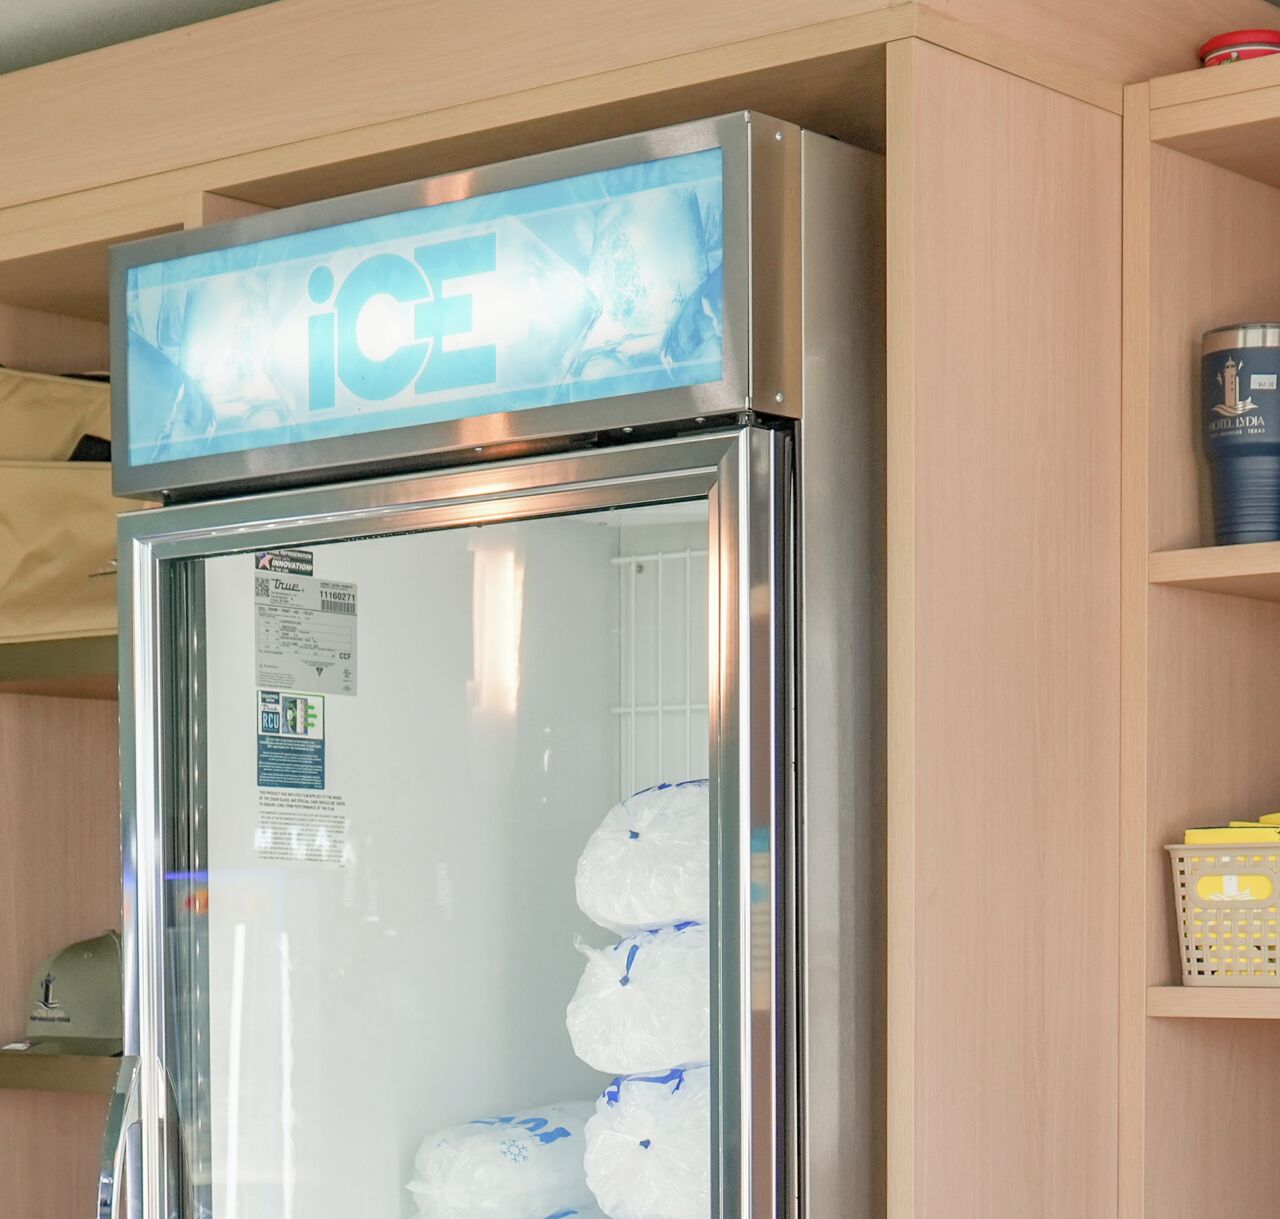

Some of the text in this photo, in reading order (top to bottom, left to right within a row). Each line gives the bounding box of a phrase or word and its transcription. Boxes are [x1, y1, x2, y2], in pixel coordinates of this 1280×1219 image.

[307, 229, 496, 412] iCE
[1236, 415, 1266, 428] LYDIA
[271, 578, 301, 593] true
[320, 591, 355, 602] 11160271
[339, 652, 351, 660] CCF
[263, 713, 279, 729] RCU
